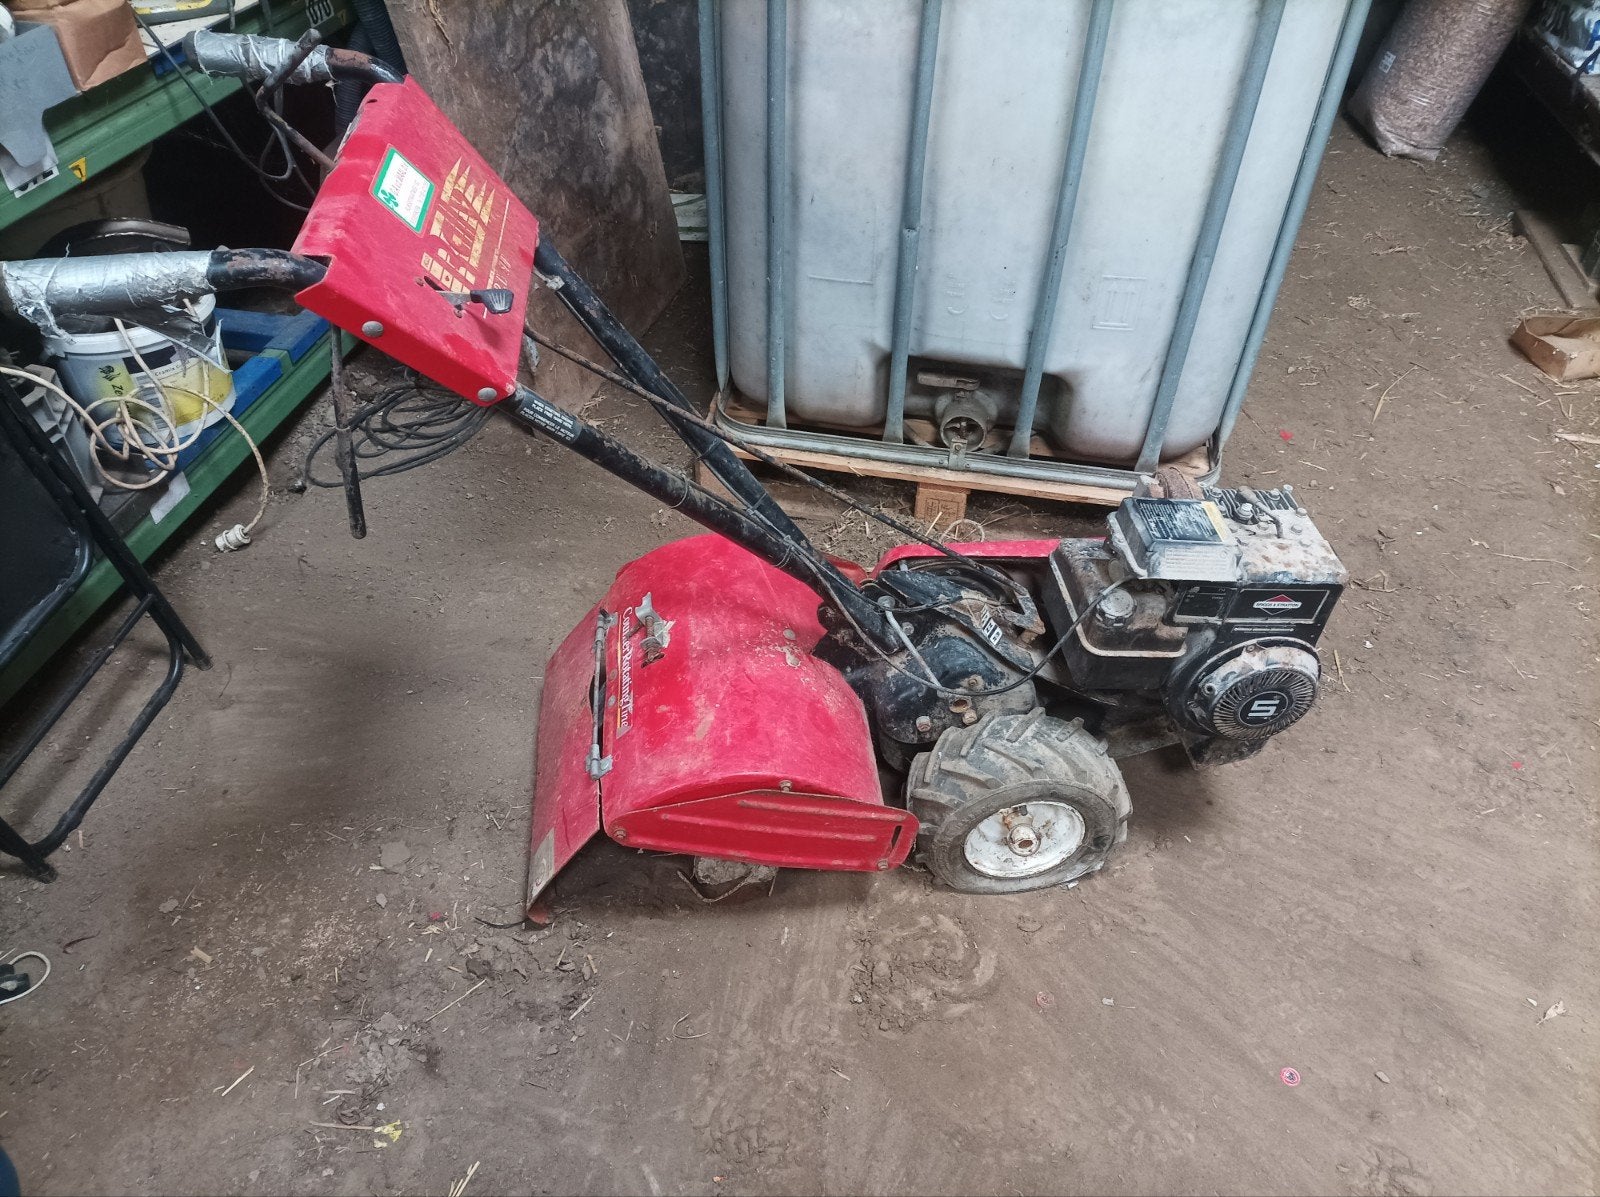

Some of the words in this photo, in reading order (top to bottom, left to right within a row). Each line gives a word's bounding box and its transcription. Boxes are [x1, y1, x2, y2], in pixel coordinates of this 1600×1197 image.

[523, 407, 535, 416] POUR
[531, 403, 544, 413] PLACE
[543, 410, 553, 419] FREE
[552, 415, 563, 424] HAND
[620, 646, 633, 704] Rotating
[621, 701, 632, 727] Tine
